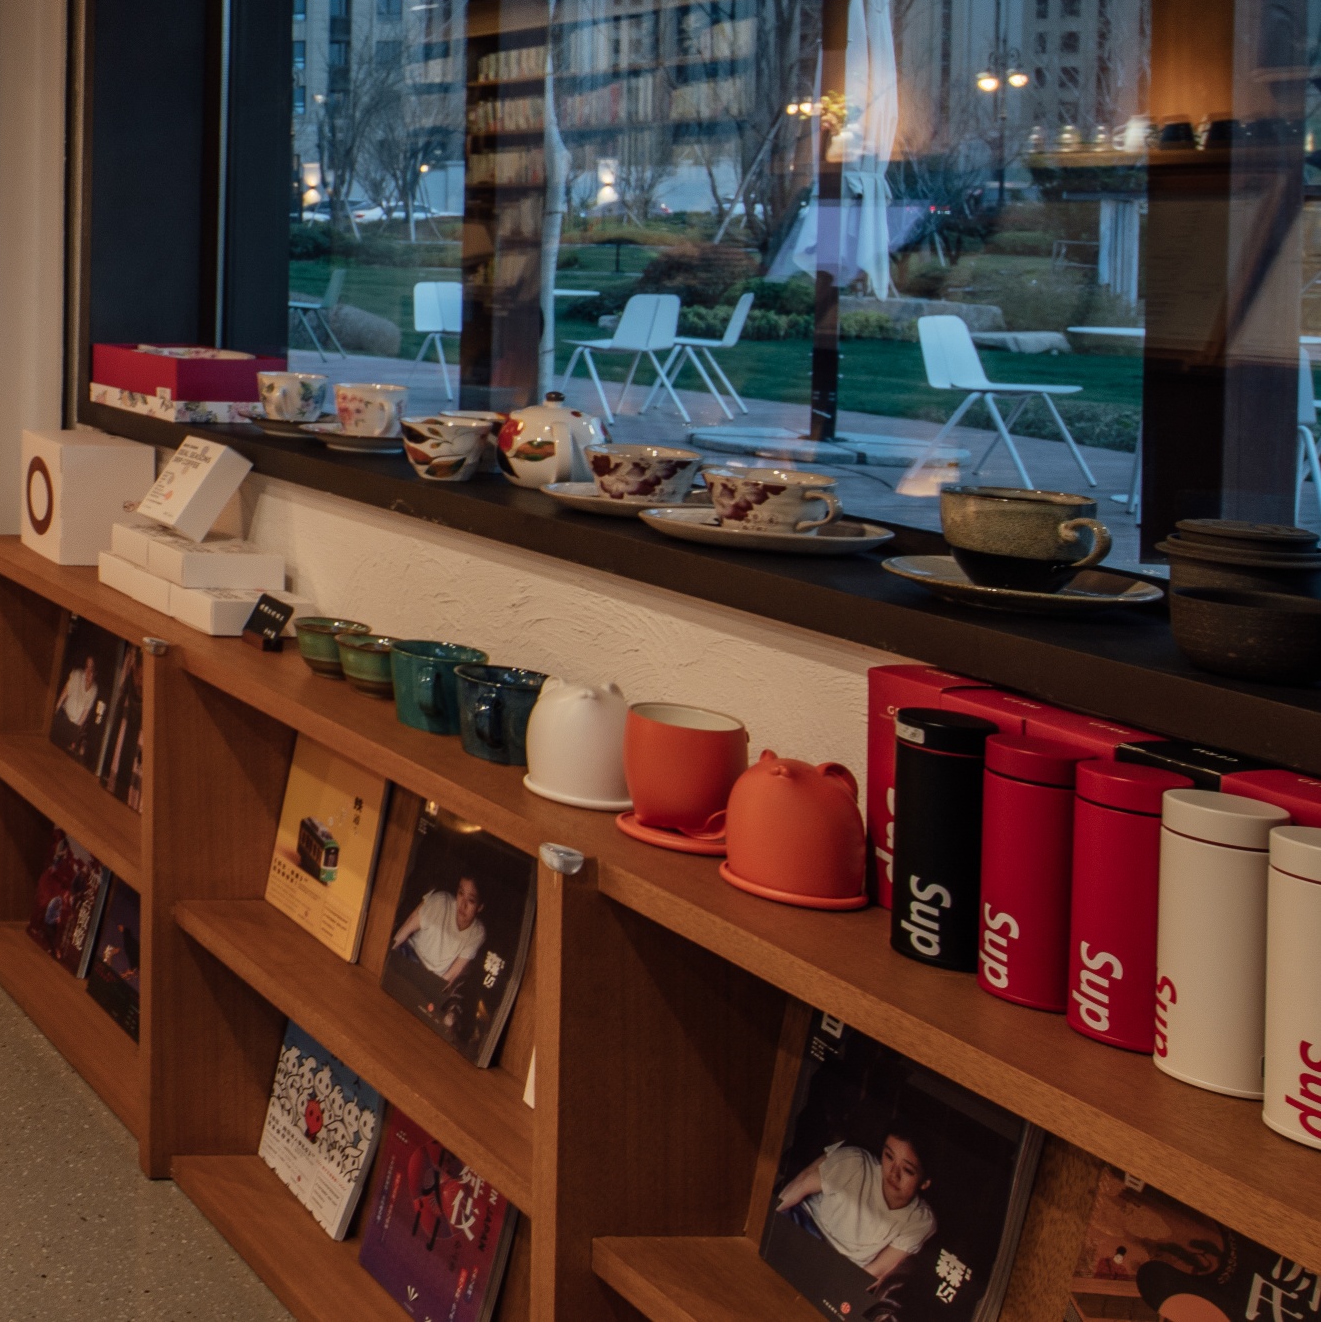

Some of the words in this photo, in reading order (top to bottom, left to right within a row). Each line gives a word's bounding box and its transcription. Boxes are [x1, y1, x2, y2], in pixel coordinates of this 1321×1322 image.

[900, 874, 952, 957] Sup
[980, 901, 1020, 989] Sup
[1071, 940, 1124, 1032] Sup
